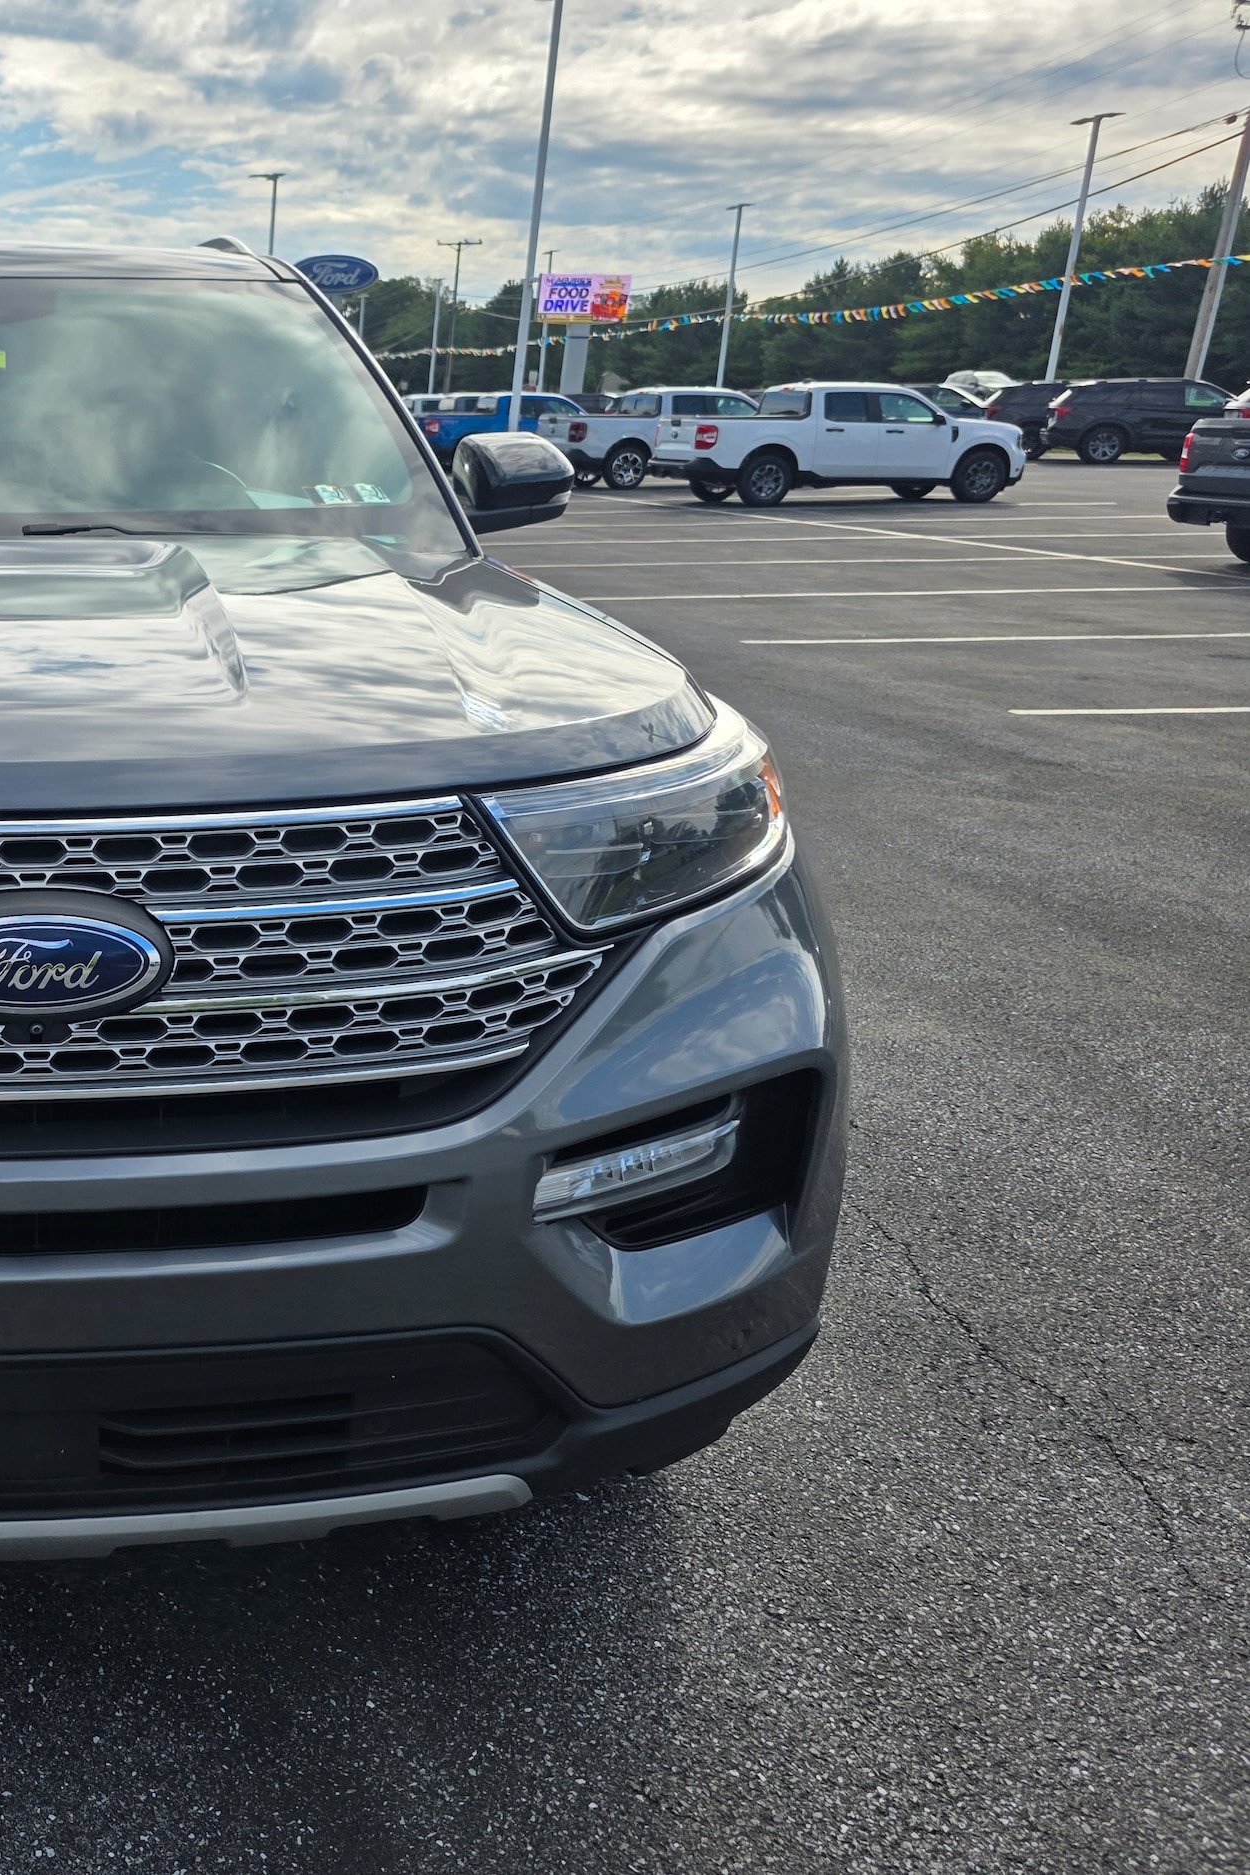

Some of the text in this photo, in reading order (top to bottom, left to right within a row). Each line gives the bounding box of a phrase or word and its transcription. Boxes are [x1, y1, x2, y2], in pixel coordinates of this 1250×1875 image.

[308, 261, 362, 286] Ford
[549, 287, 590, 299] FOOD
[543, 300, 590, 313] DRIVE
